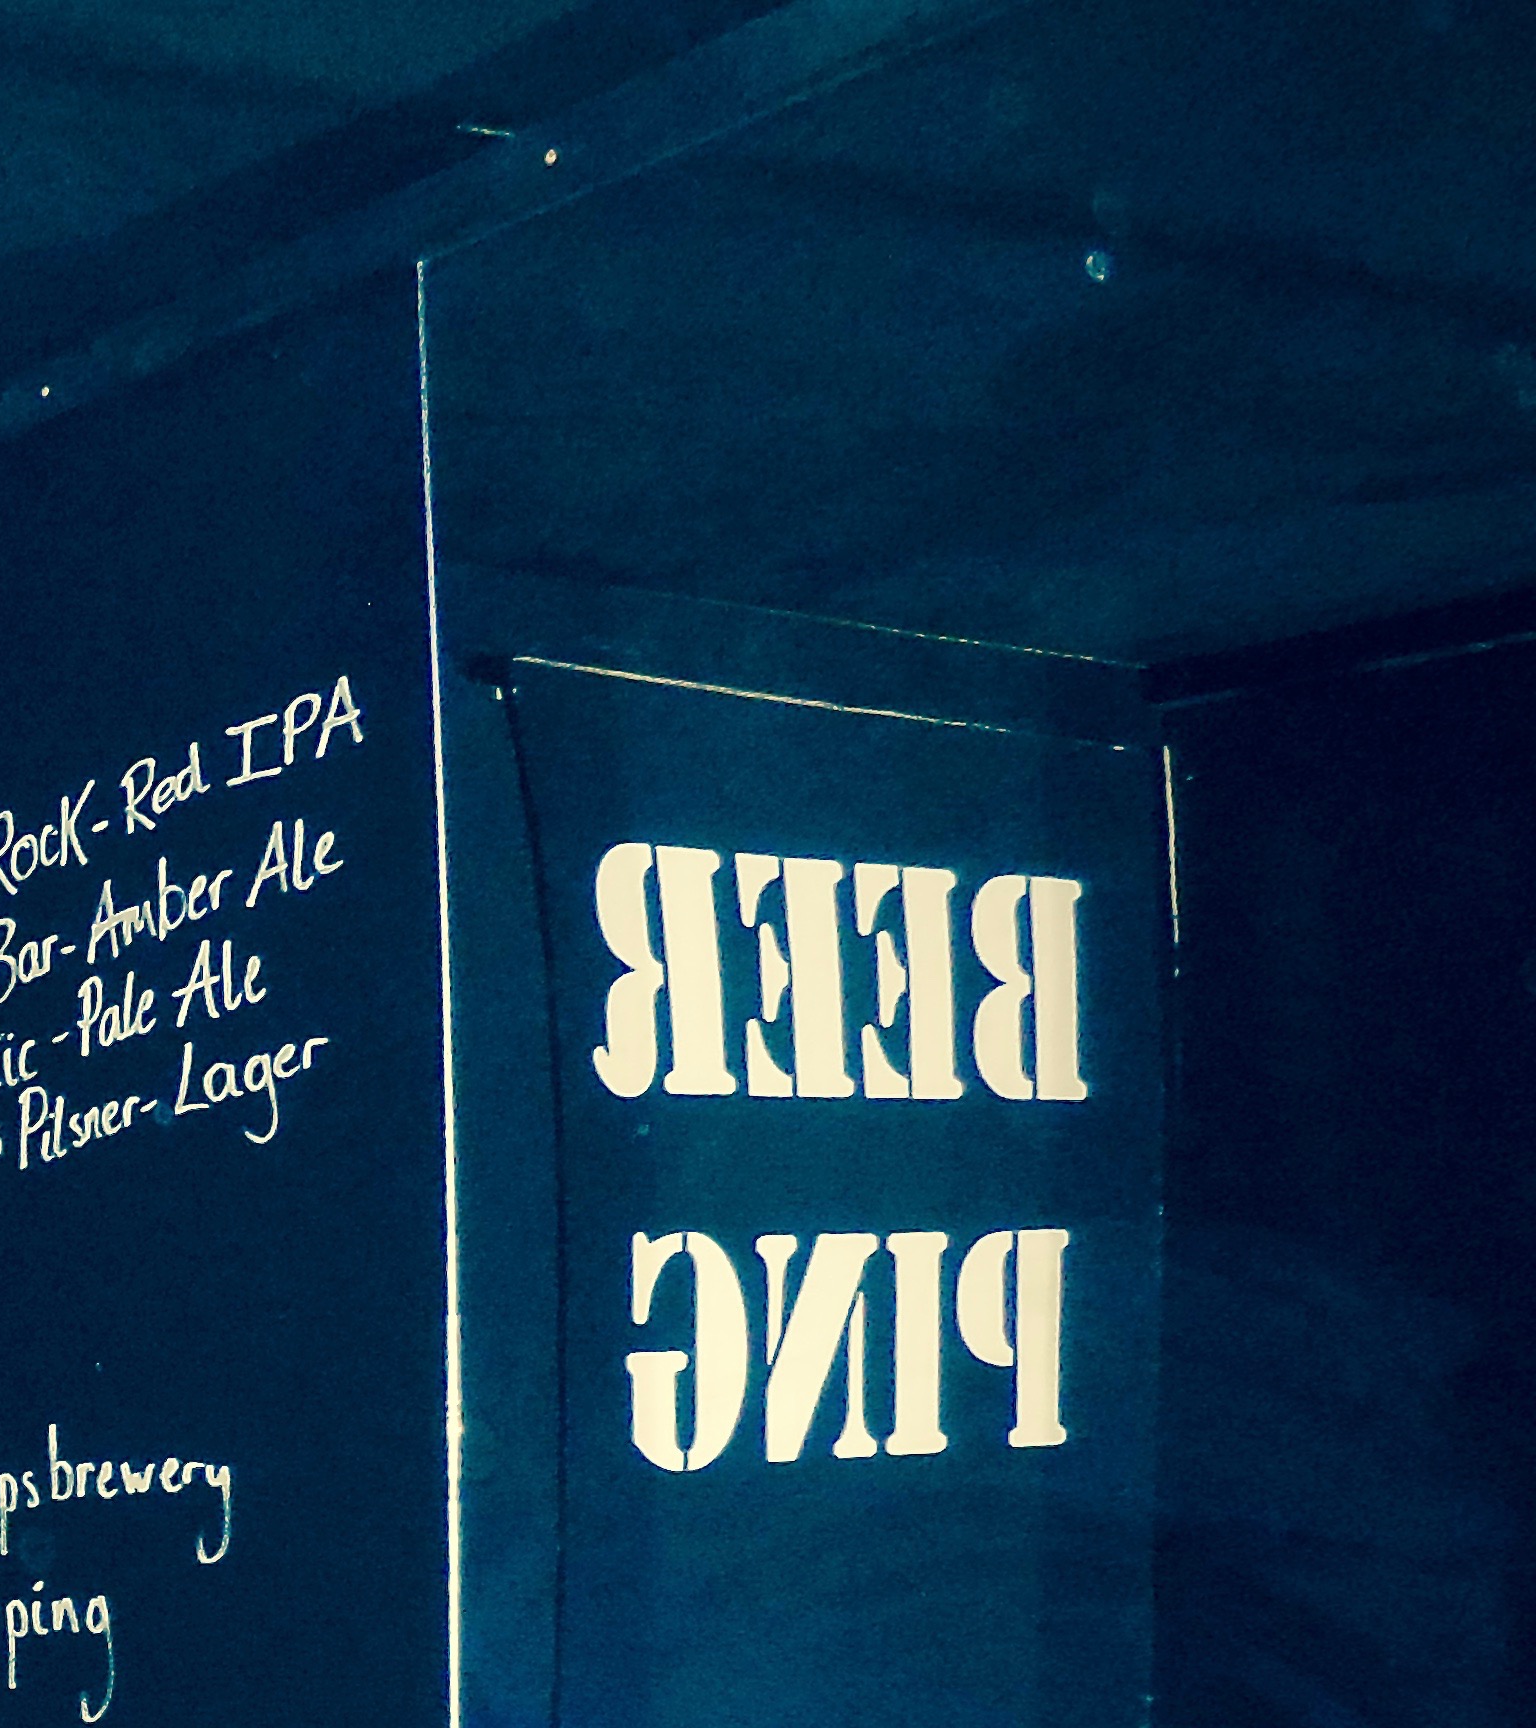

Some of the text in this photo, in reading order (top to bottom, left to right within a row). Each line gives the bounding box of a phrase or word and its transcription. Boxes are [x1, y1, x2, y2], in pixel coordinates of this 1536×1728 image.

[225, 675, 364, 787] IPA
[246, 818, 343, 908] Ale
[172, 940, 266, 1028] Ale
